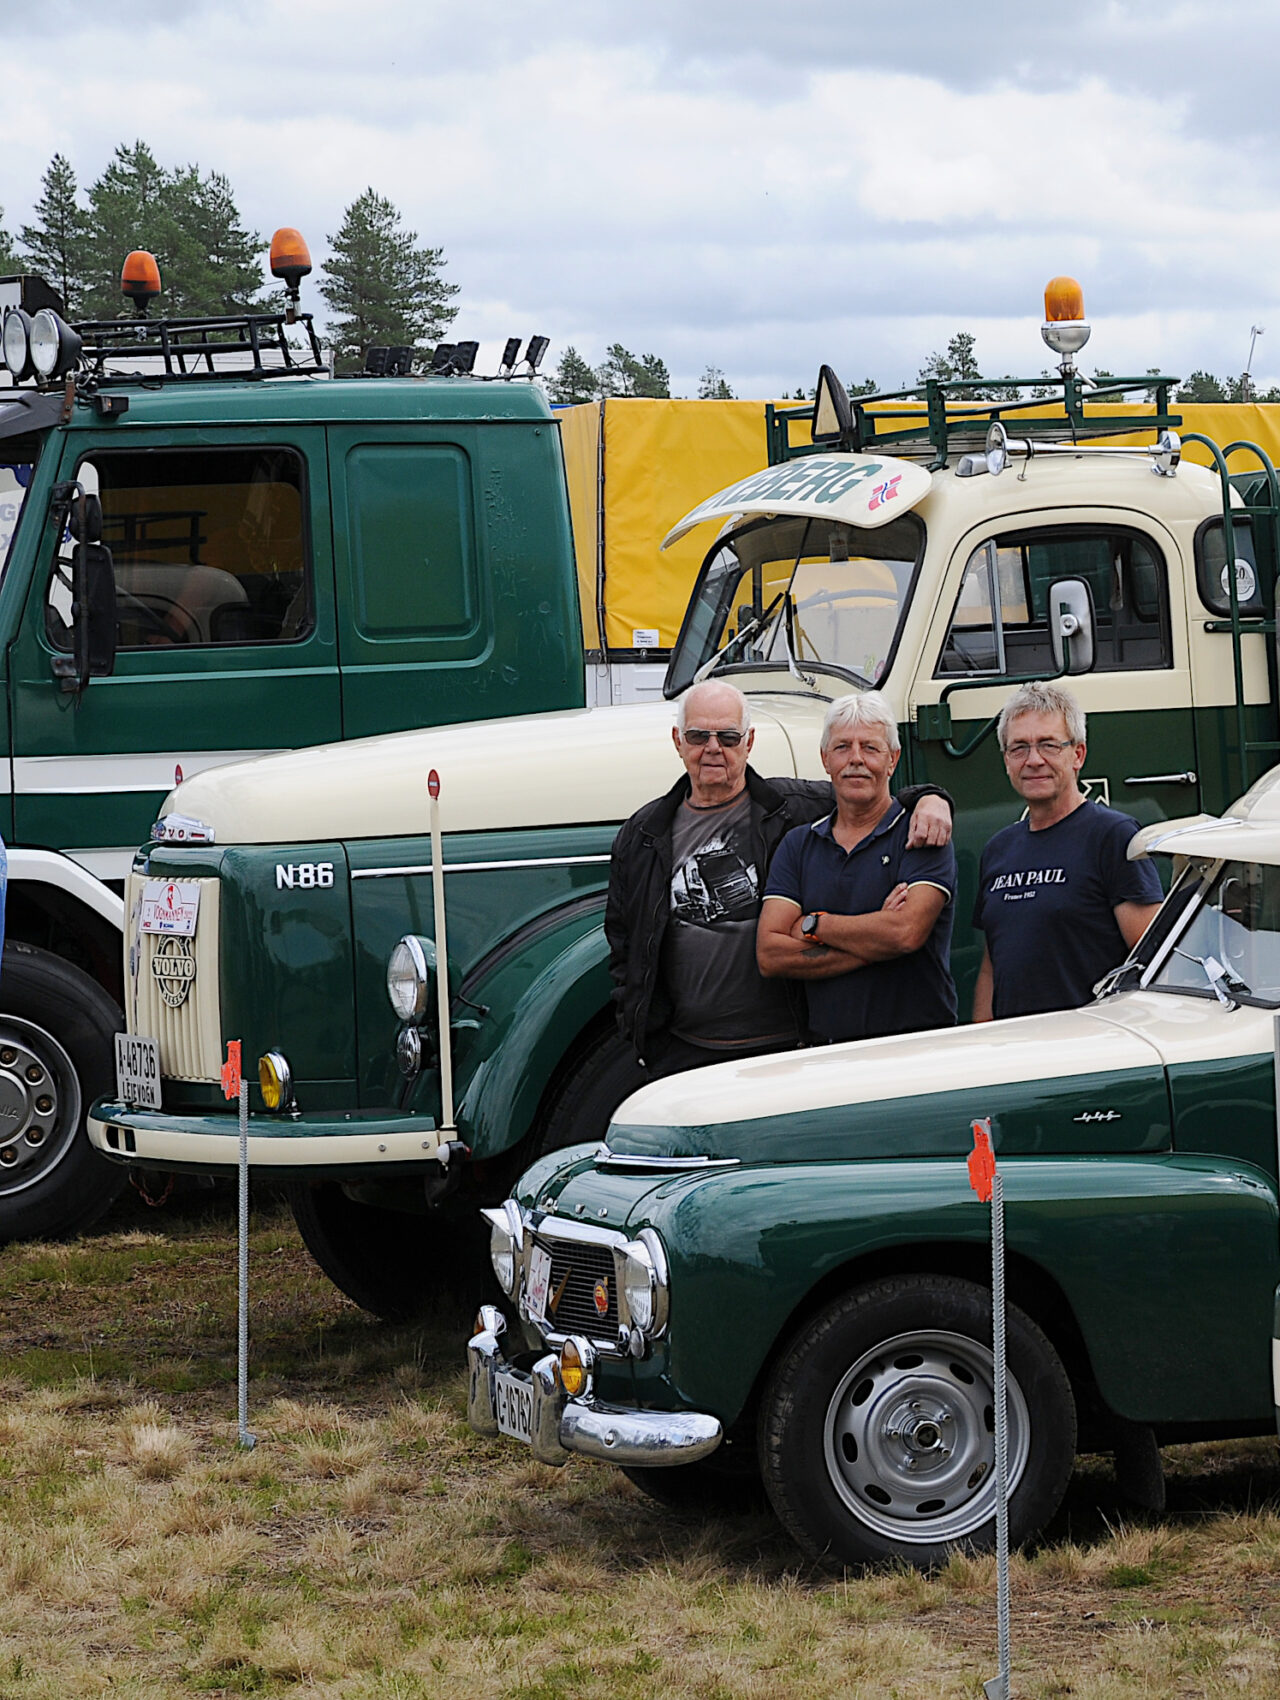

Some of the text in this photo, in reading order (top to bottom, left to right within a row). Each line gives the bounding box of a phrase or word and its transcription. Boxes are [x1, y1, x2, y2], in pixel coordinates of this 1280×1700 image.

[276, 862, 334, 890] N86
[990, 868, 1066, 892] JEAN PAUL
[154, 958, 195, 976] VOLVO
[119, 1040, 156, 1079] A-48736
